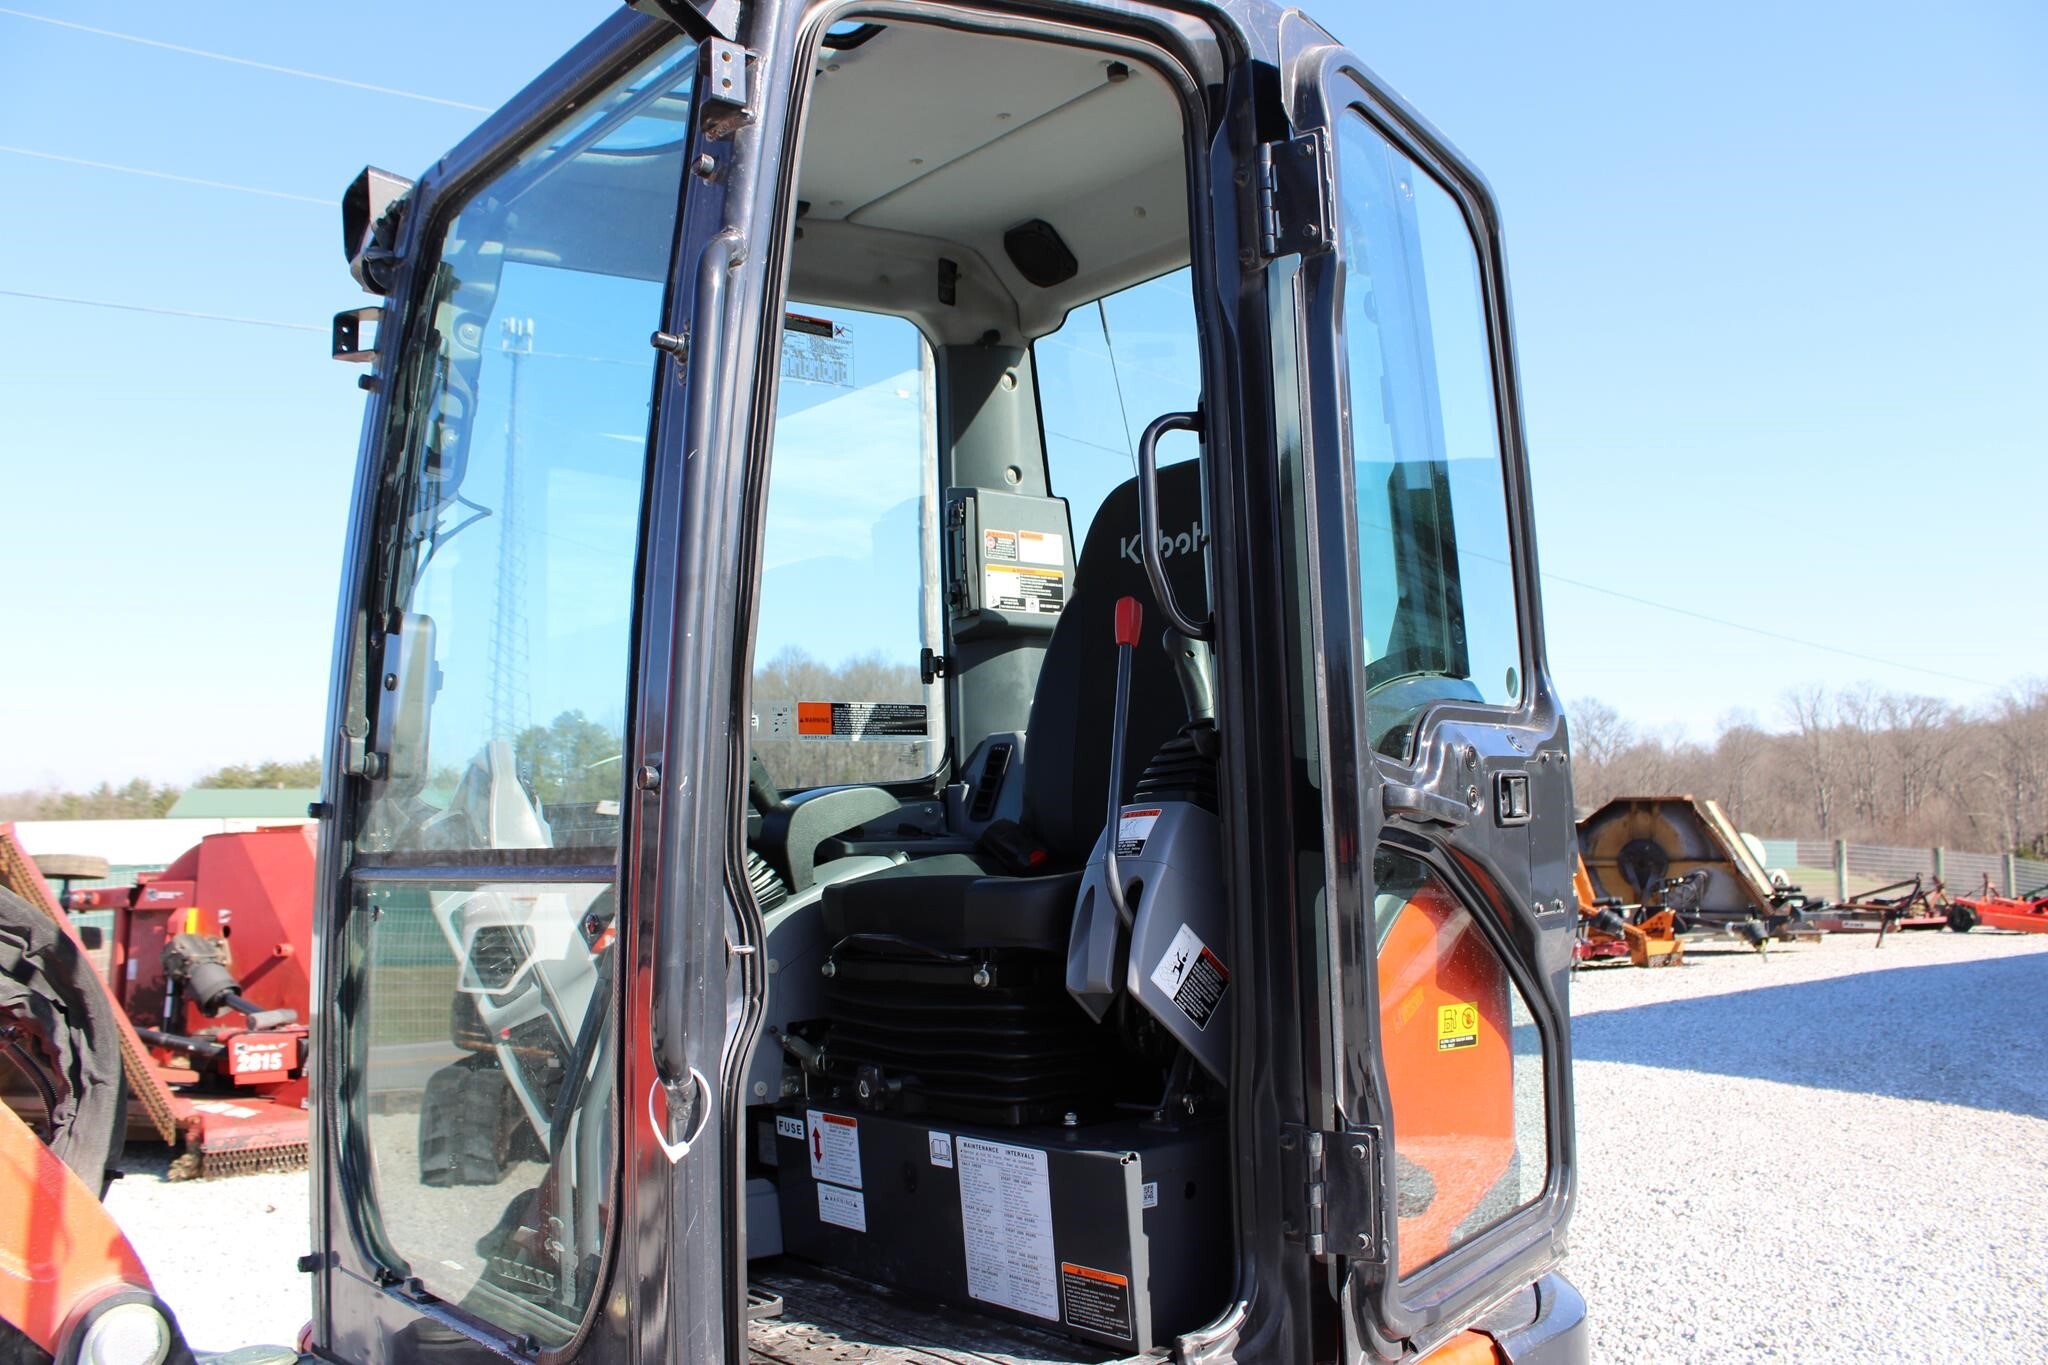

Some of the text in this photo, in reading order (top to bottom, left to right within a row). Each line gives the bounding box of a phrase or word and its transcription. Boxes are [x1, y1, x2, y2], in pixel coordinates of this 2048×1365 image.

[1120, 521, 1201, 564] Kbot
[778, 1120, 802, 1136] FUSE
[963, 1142, 1035, 1160] MAINTENANCE INTERVALS
